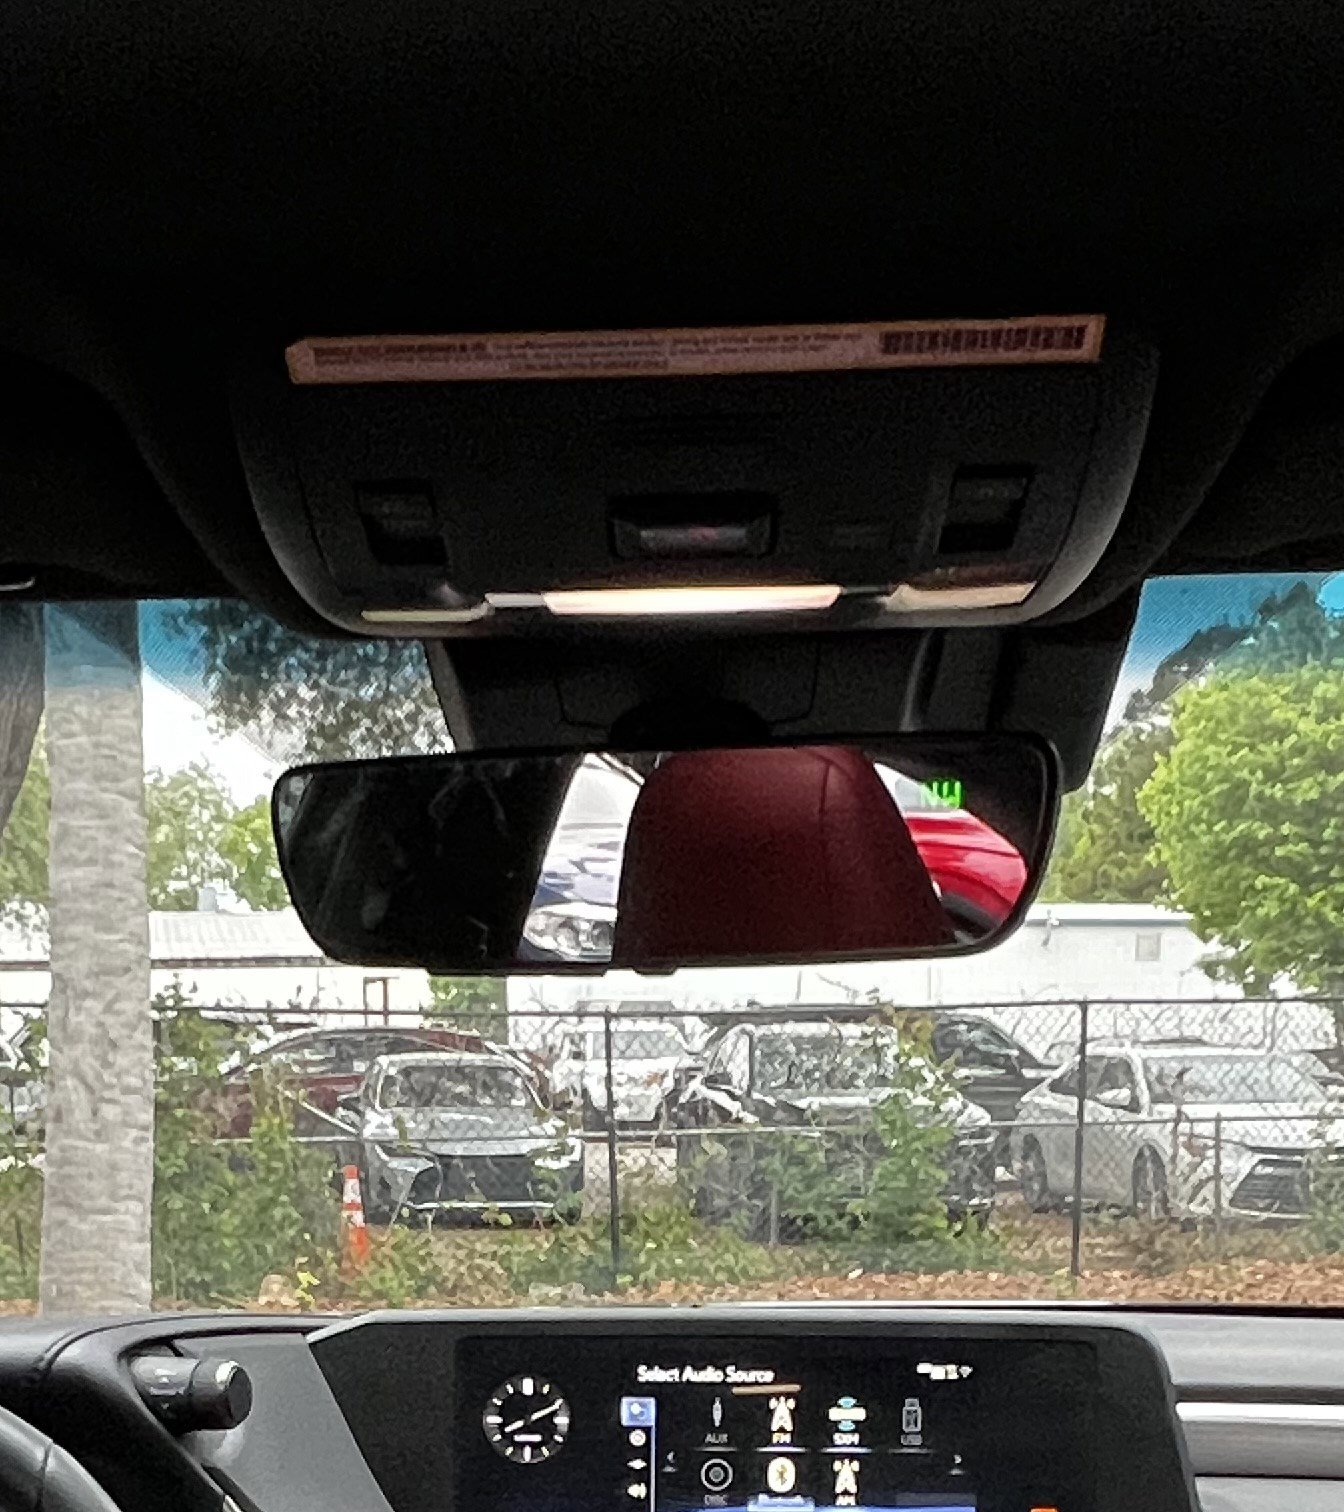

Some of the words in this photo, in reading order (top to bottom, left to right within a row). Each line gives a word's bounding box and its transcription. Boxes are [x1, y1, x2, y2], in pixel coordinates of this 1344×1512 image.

[636, 1364, 680, 1383] Select
[681, 1365, 724, 1383] Audio
[725, 1364, 776, 1383] Source
